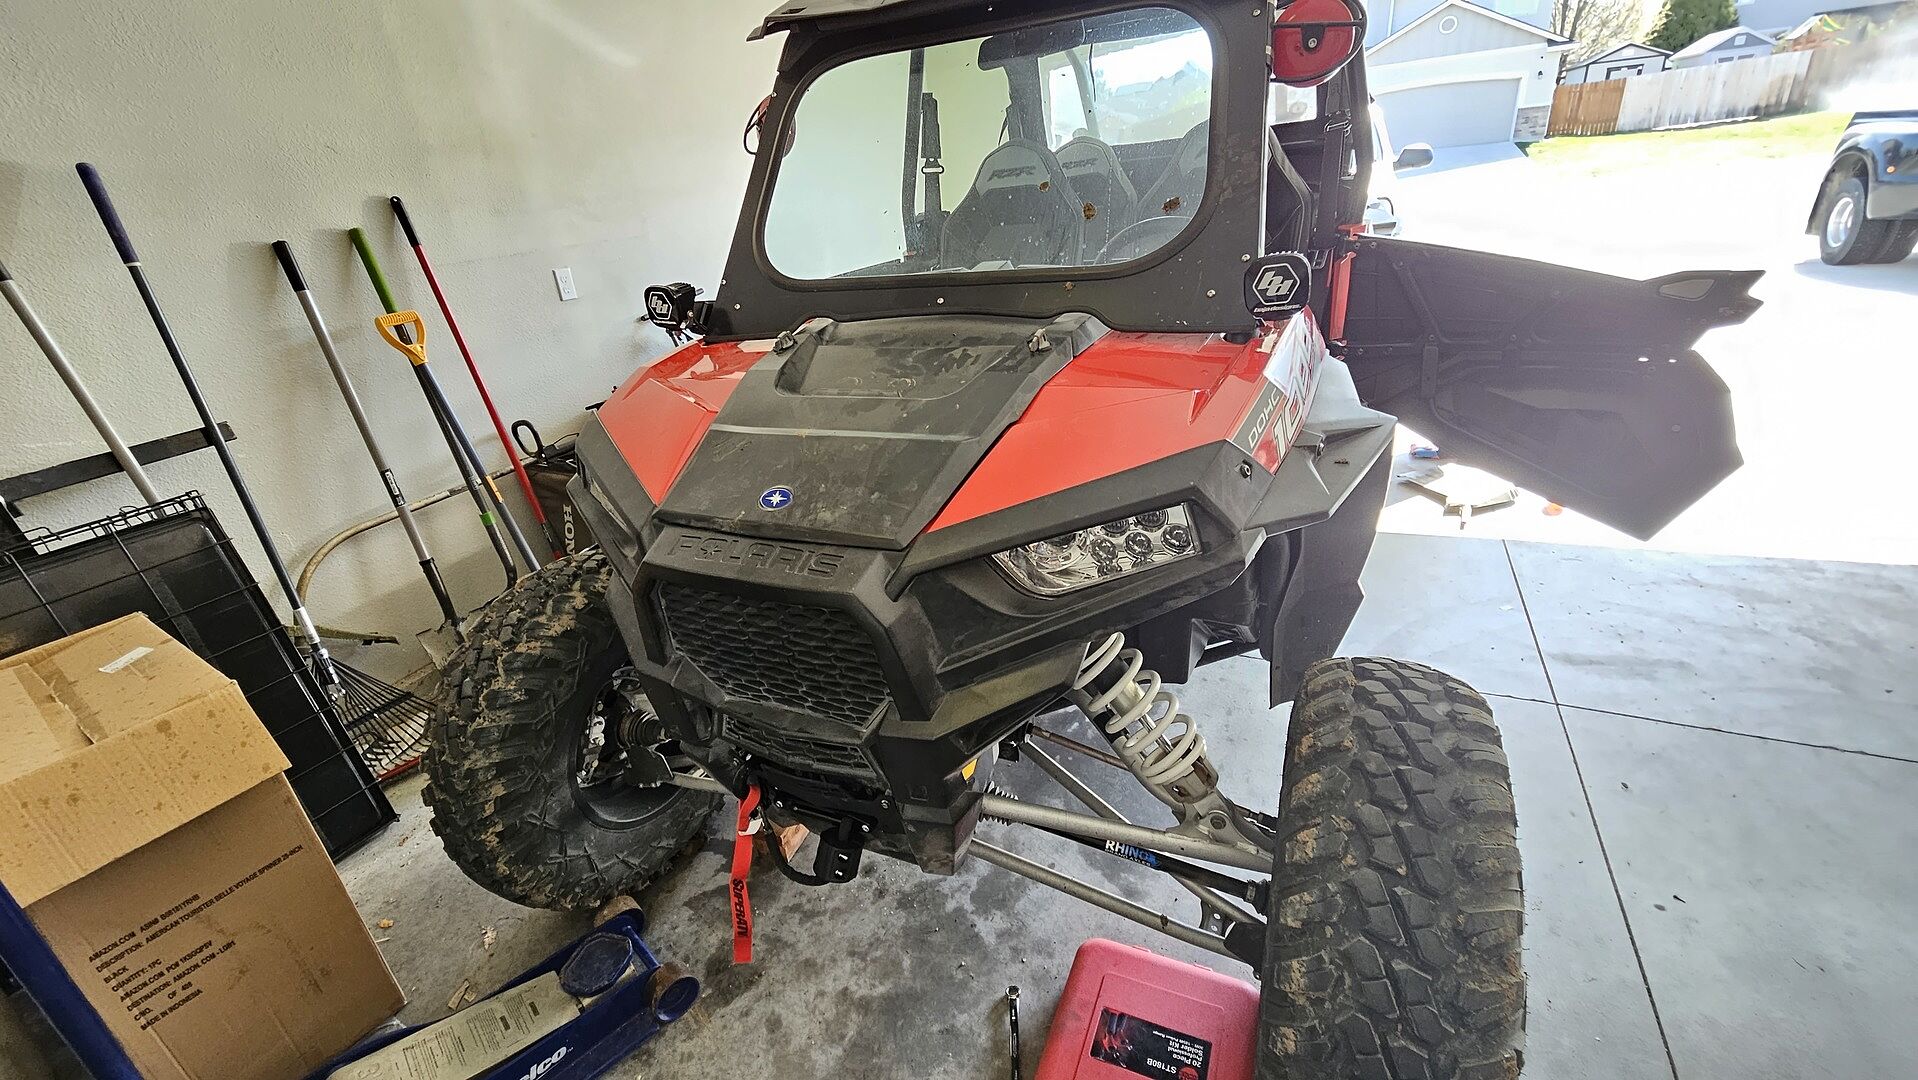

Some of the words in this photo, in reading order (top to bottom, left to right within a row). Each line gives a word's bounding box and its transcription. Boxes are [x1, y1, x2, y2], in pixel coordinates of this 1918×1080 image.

[1248, 388, 1280, 449] DOHC
[667, 534, 845, 579] POLARIS
[96, 942, 144, 972] DESCRIPTION:
[145, 919, 180, 944] AMERICAN
[179, 898, 215, 922] TOURISTER
[214, 886, 235, 902] BELLE
[234, 871, 259, 890] VOYAGE
[89, 931, 136, 962] AMAZON.COM
[103, 965, 129, 984] BLACK
[112, 967, 148, 992] QUANTITY:
[148, 958, 162, 970] 1PC
[120, 970, 166, 1002] AMAZON.COM
[126, 980, 172, 1012] DESTINATION:
[140, 1015, 161, 1032] MADE
[160, 1009, 169, 1018] IN
[168, 988, 203, 1014] INDONESIA
[167, 990, 178, 1000] OF
[1167, 1046, 1203, 1062] Professional
[1169, 1040, 1180, 1048] Kit
[1172, 1054, 1192, 1065] Piece
[1180, 1044, 1204, 1057] Solder
[1192, 1060, 1202, 1068] 20
